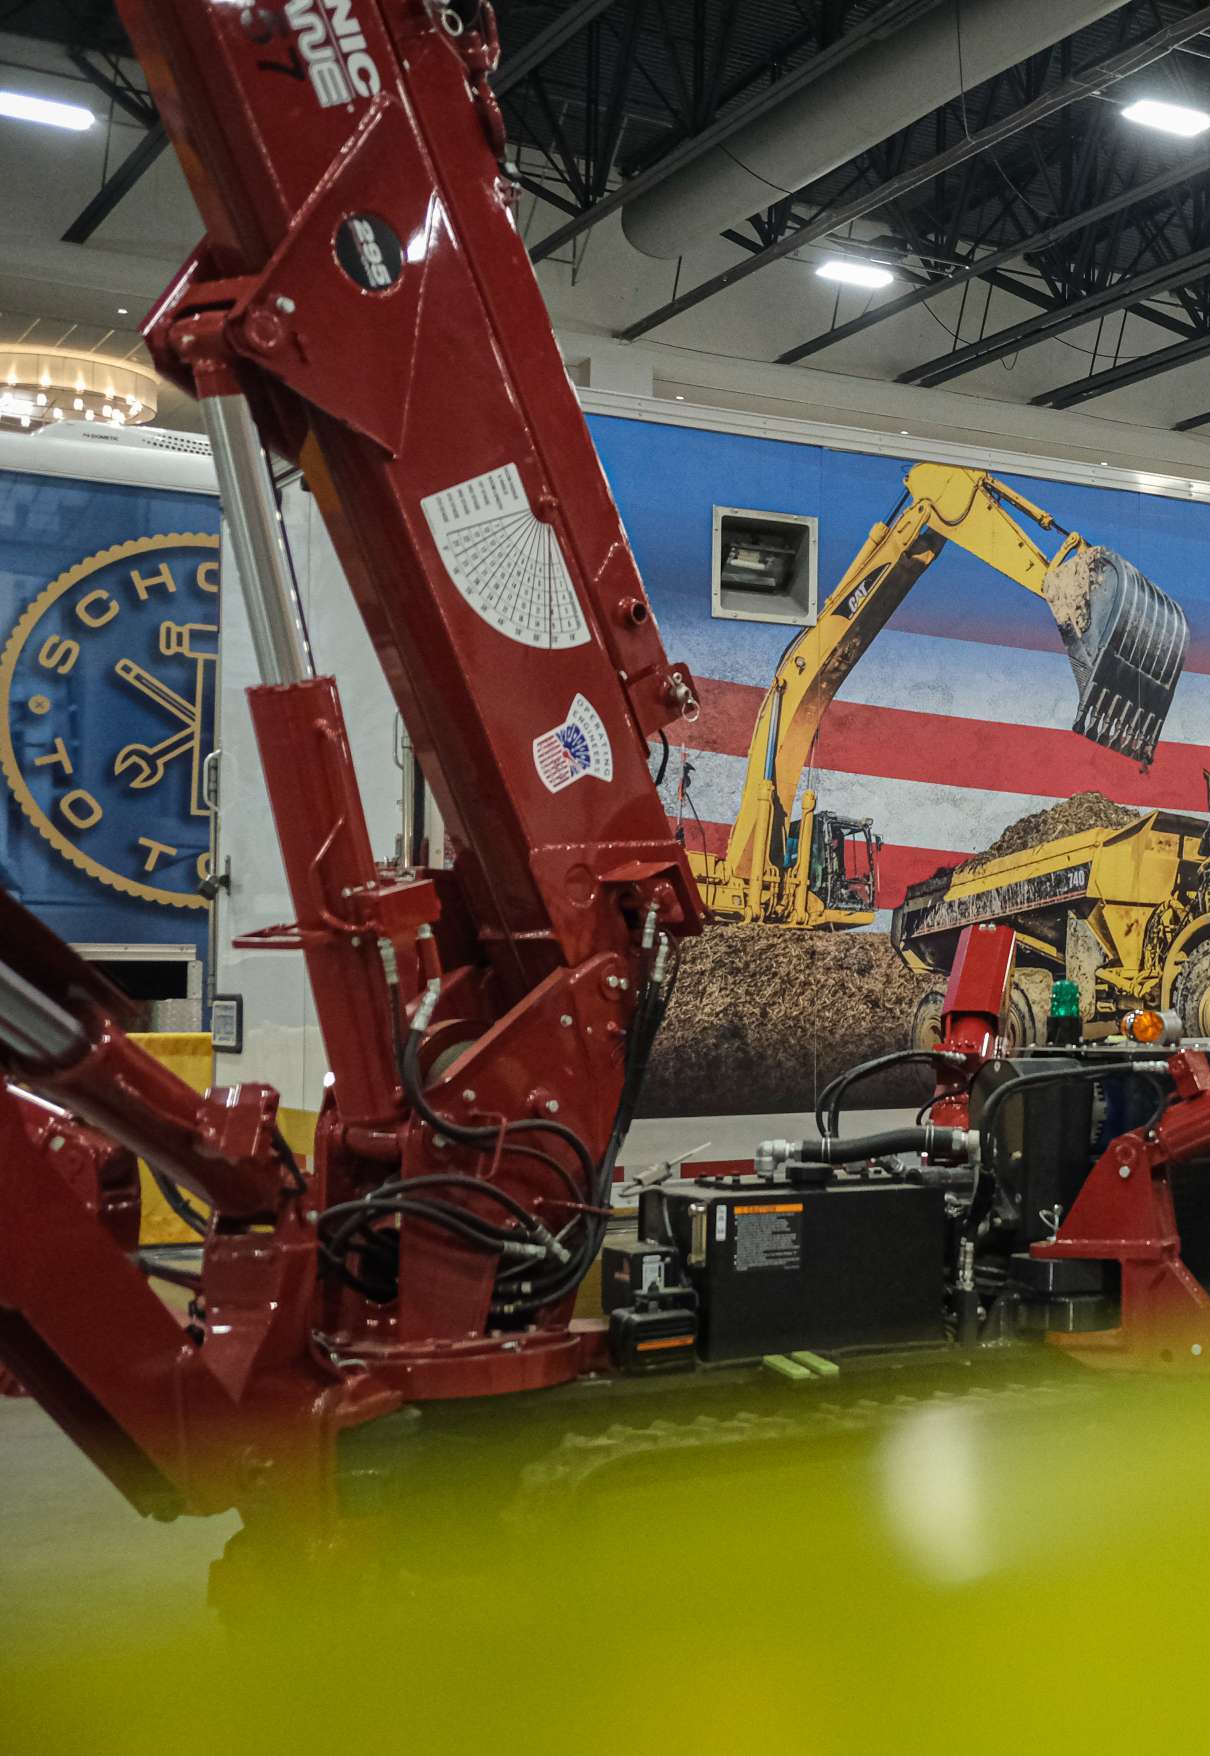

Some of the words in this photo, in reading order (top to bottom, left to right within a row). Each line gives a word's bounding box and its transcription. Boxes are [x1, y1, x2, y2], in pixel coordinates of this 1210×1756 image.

[352, 218, 392, 286] 295
[848, 579, 868, 613] CAT
[1067, 870, 1086, 889] 740
